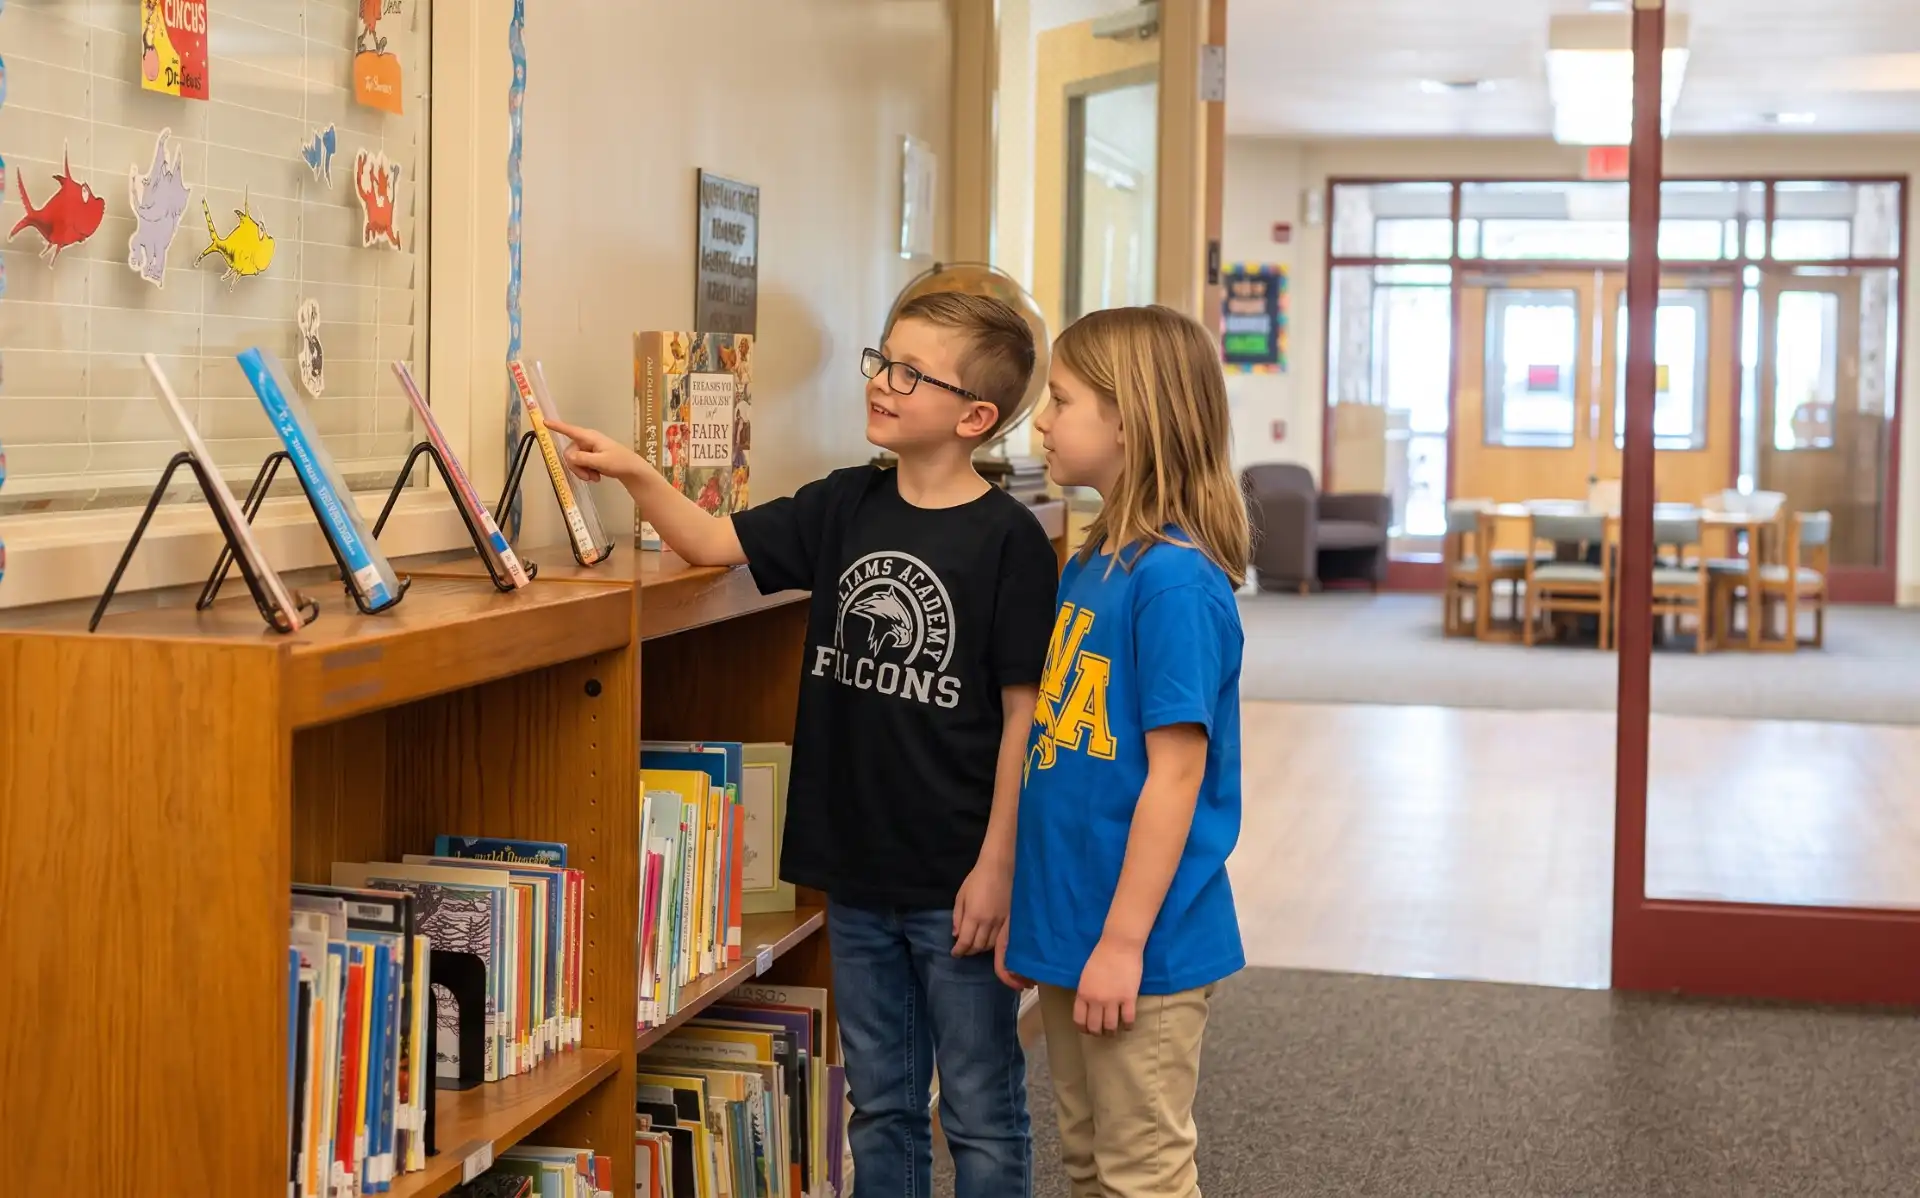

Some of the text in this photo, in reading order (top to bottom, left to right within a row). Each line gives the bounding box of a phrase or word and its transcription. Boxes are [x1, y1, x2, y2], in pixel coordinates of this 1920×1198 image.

[165, 66, 181, 87] Dr.
[692, 423, 729, 439] FAIRY
[691, 443, 729, 459] TALES
[838, 558, 946, 664] LIAMS ACADEMY
